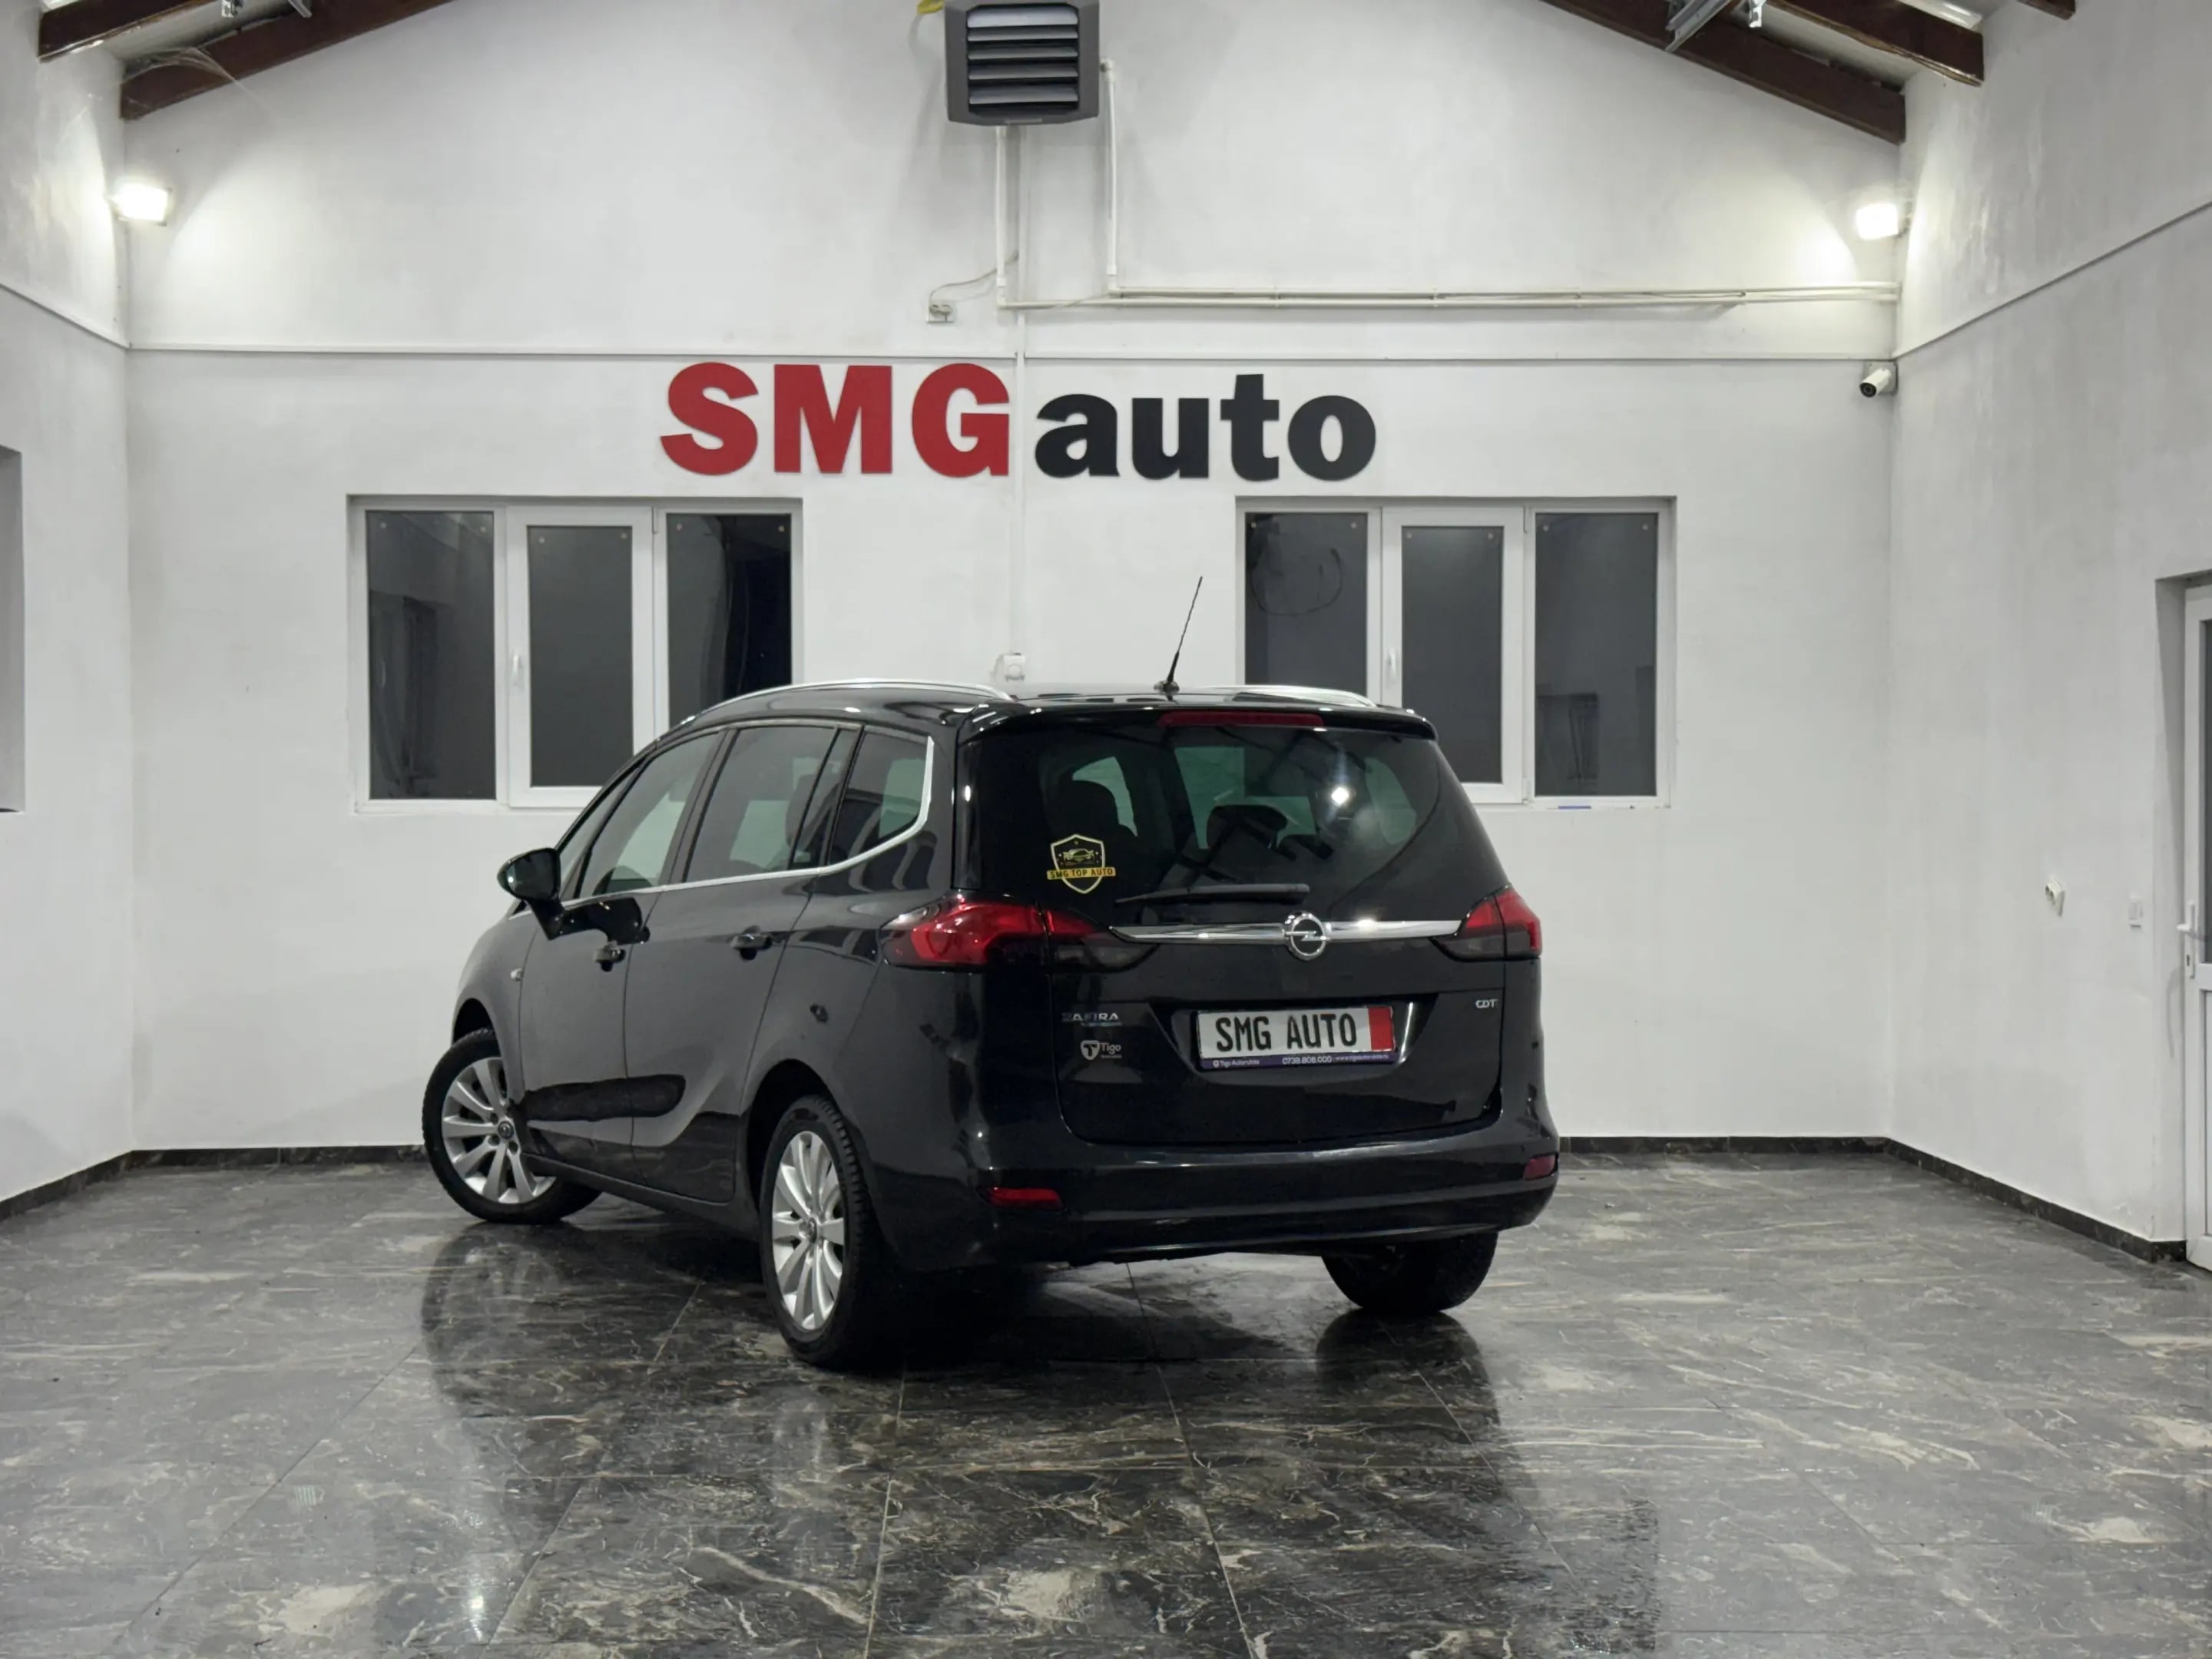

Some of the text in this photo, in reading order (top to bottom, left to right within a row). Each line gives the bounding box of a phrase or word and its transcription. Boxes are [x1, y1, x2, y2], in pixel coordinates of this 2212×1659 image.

[661, 362, 1377, 482] SMG auto
[1050, 870, 1068, 879] SMG
[1091, 867, 1114, 876] AUTO
[1215, 1012, 1357, 1052] SMG AUTO
[1100, 1042, 1121, 1055] Tigo
